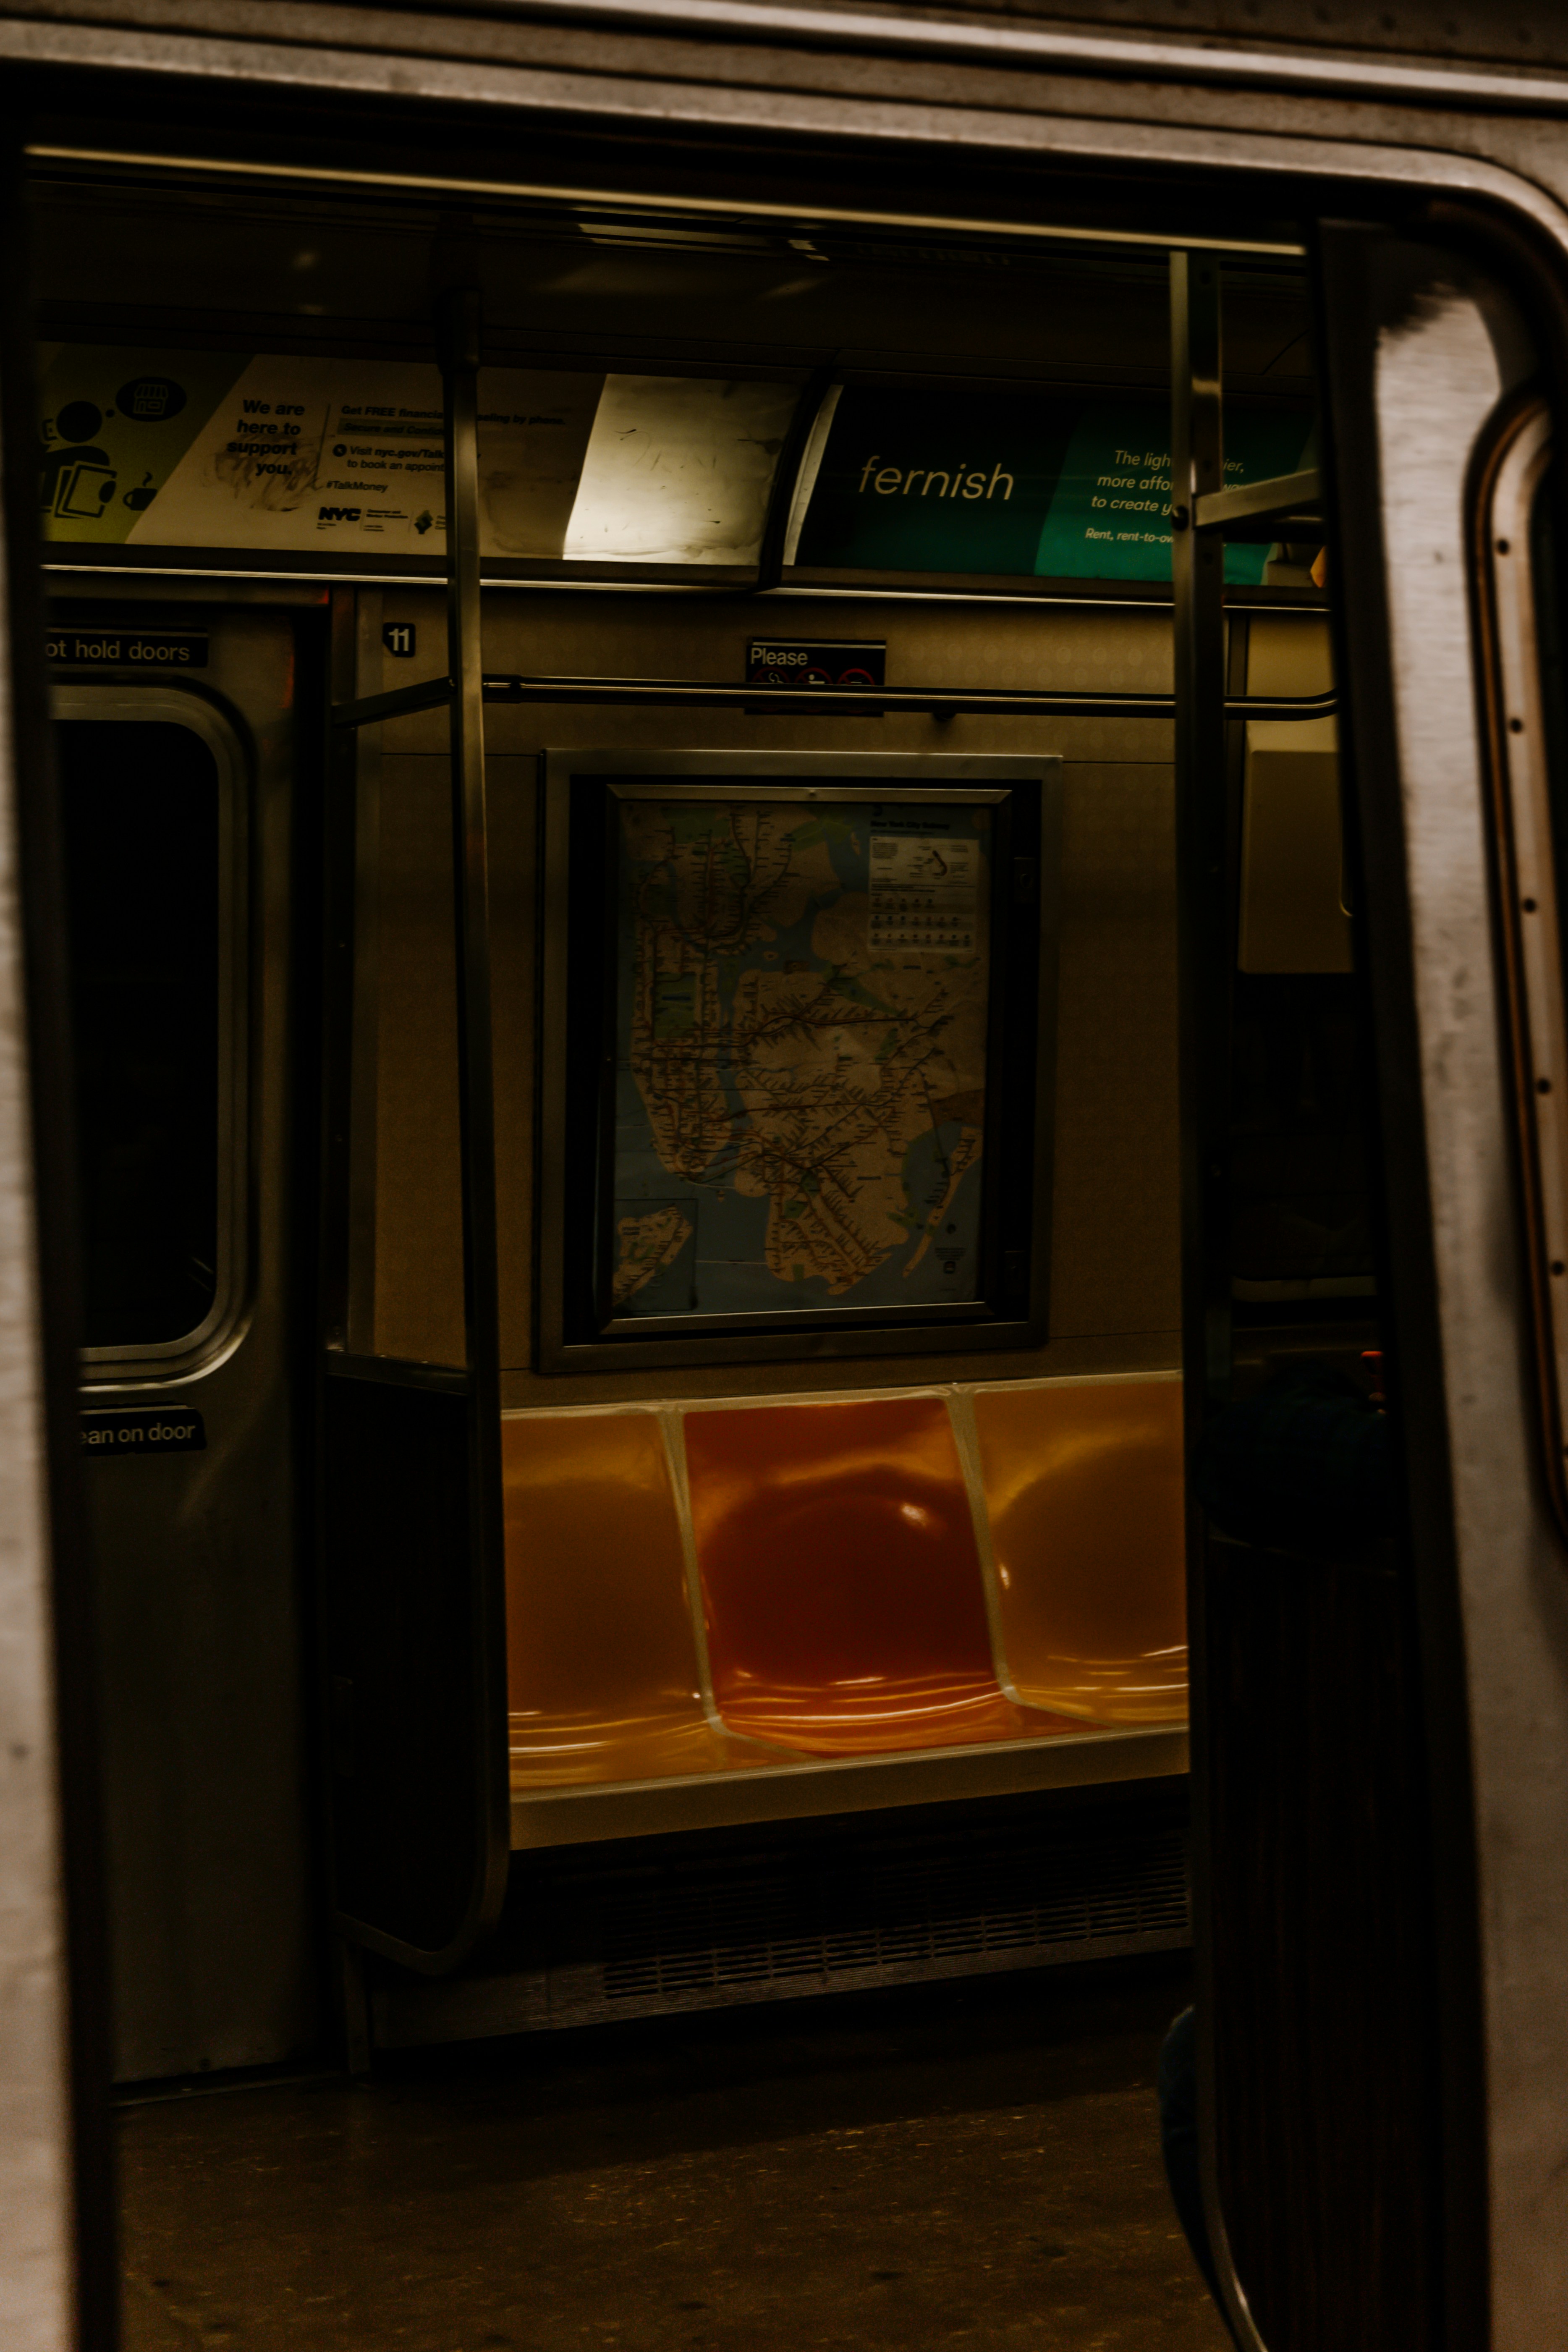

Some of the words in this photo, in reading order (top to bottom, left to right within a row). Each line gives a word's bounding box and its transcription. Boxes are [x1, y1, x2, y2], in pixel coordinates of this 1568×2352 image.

[243, 400, 270, 414] We
[275, 404, 305, 415] are
[341, 406, 361, 415] Get
[365, 407, 395, 416] FREE
[513, 414, 526, 424] by
[237, 420, 278, 434] here
[284, 423, 301, 435] to
[344, 423, 380, 432] Secure
[228, 443, 297, 456] support
[350, 446, 372, 456] Visit
[360, 460, 387, 469] book
[1115, 450, 1141, 466] The
[256, 464, 292, 476] you.
[859, 455, 1014, 500] fernish
[327, 480, 388, 493] #TalkMoney
[1097, 476, 1136, 489] more
[1092, 495, 1107, 508] to
[1110, 498, 1159, 512] create
[319, 507, 361, 521] NYC
[1085, 527, 1114, 542] Rent,
[388, 628, 410, 651] 11
[75, 639, 121, 660] hold
[128, 641, 191, 662] doors
[750, 647, 809, 666] Please
[117, 1427, 145, 1443] on
[148, 1422, 196, 1441] door
